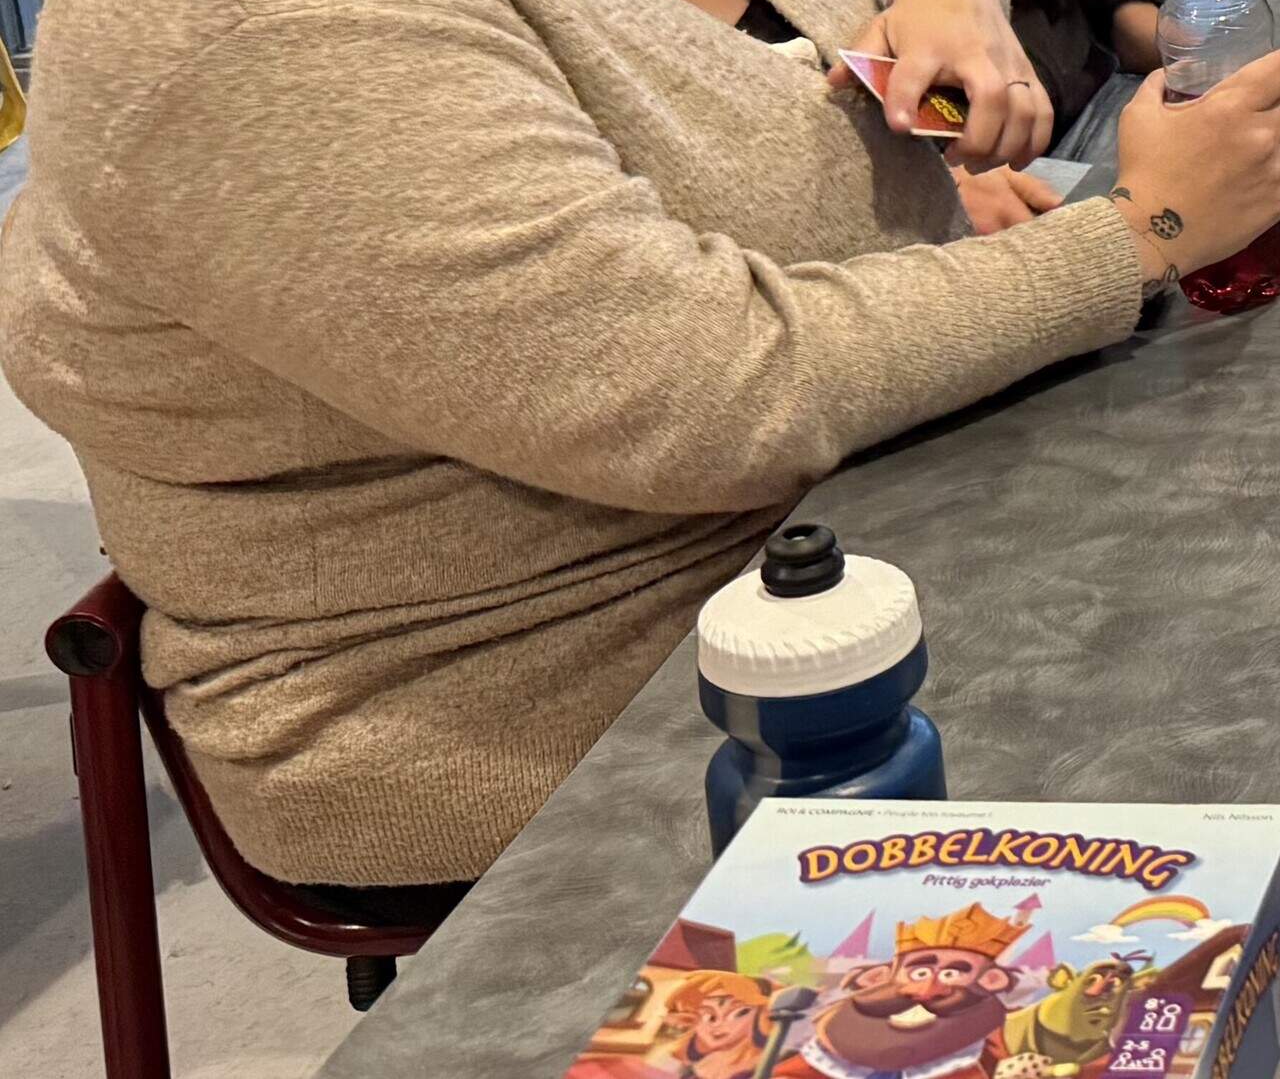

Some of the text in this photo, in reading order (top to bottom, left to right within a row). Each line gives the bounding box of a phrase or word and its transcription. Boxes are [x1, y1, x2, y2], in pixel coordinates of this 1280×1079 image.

[803, 829, 1194, 887] DOBBELKONING
[921, 874, 1052, 889] Pittig gokplezier
[1123, 1040, 1150, 1051] 2-5
